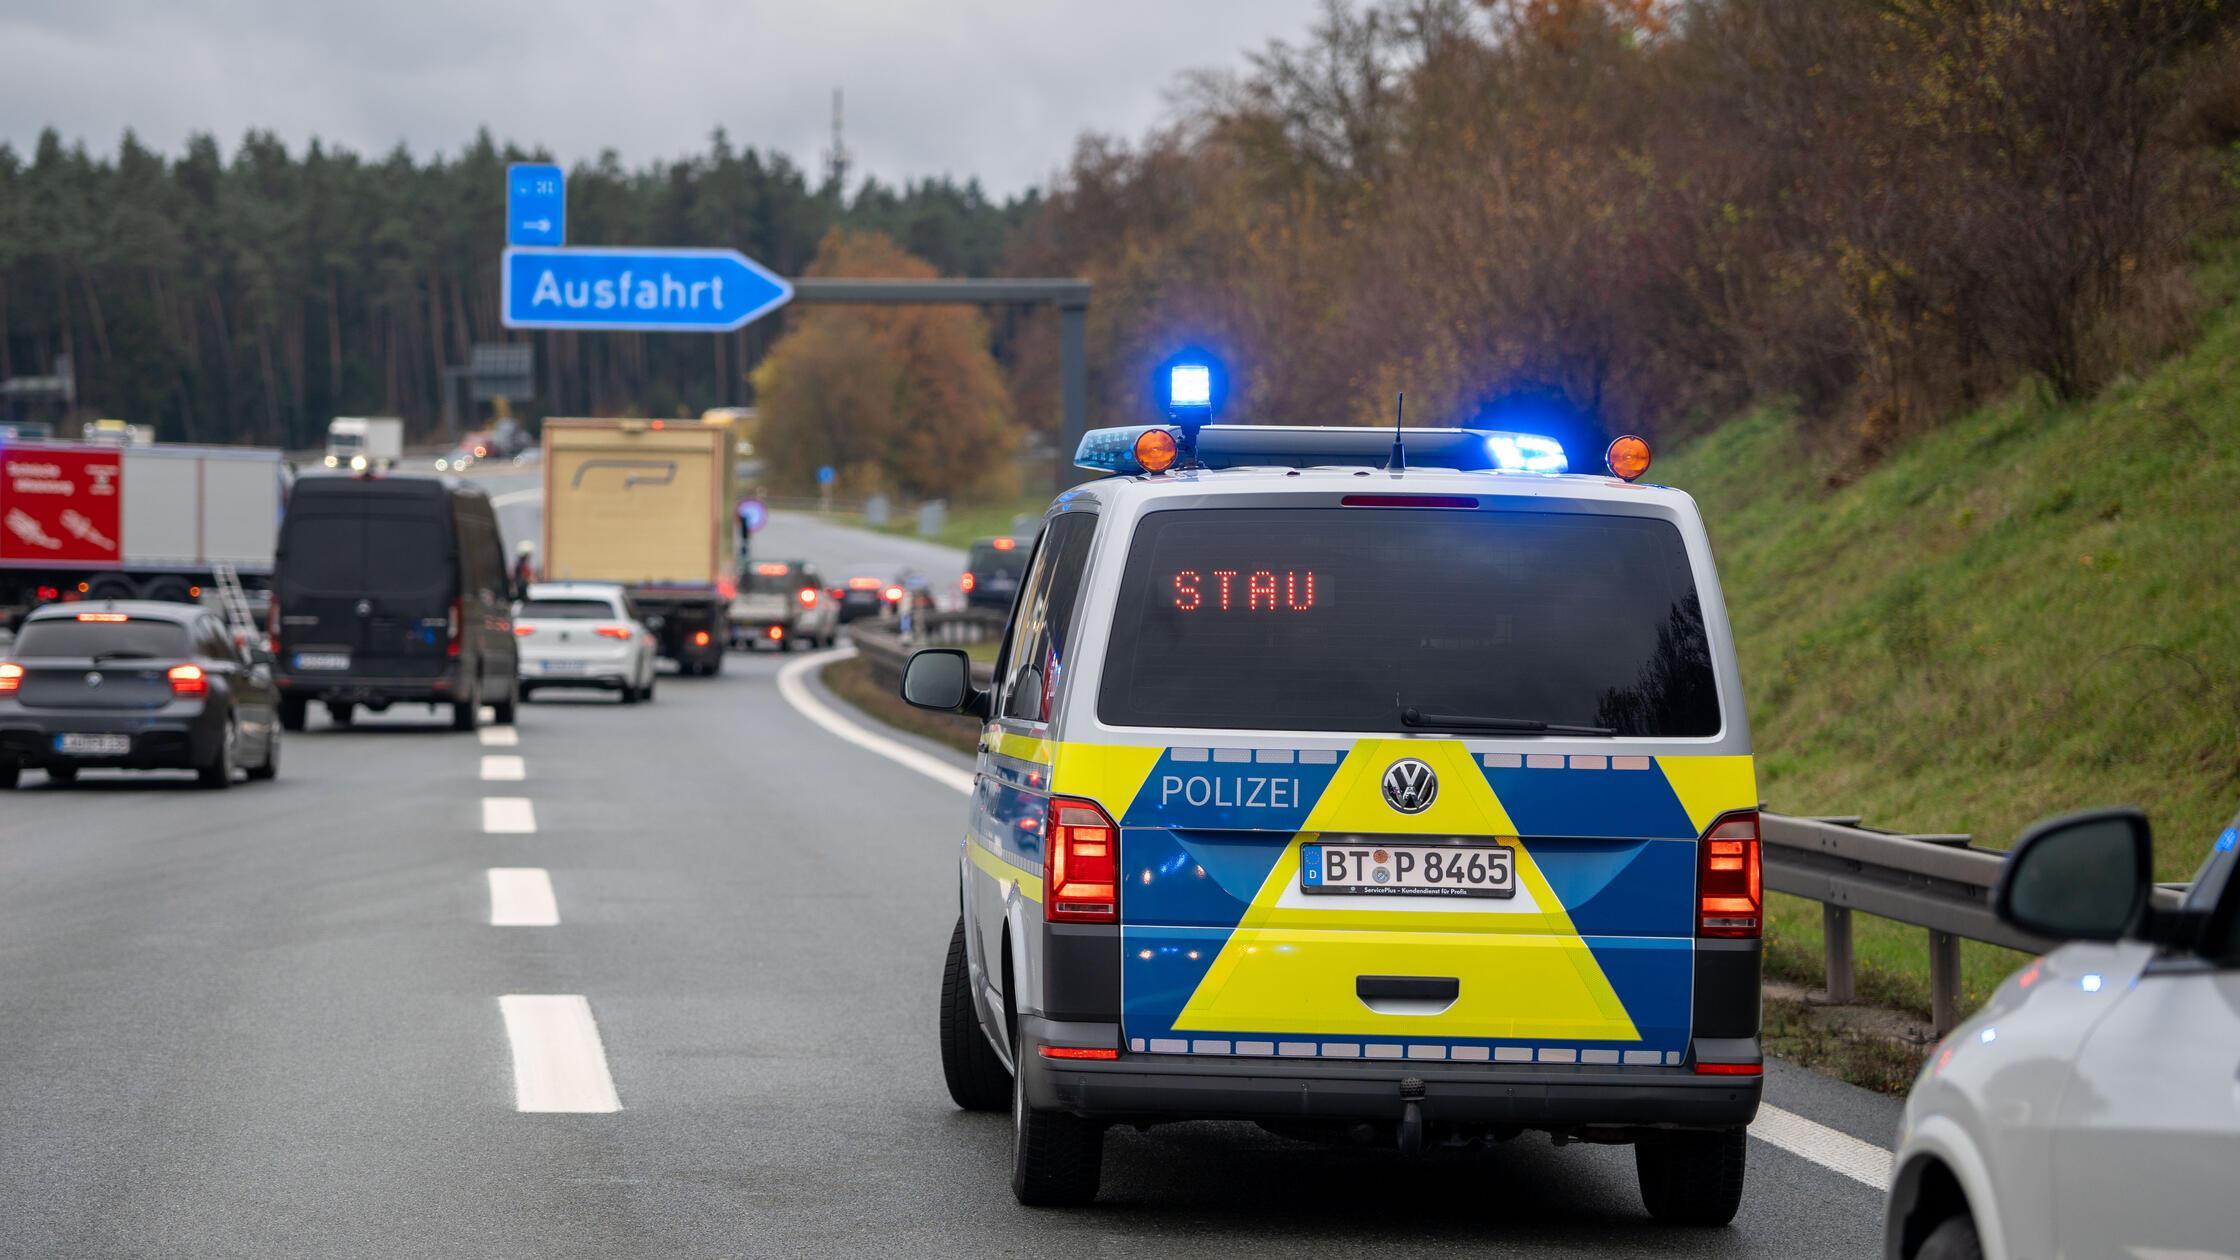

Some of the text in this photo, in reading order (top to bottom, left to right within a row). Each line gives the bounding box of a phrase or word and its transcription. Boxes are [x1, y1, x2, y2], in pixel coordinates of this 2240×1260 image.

[531, 269, 724, 311] Ausfahrt
[1175, 570, 1314, 610] STAU
[1161, 775, 1300, 808] POLIZEI
[1309, 850, 1508, 885] D BT P 8465
[1364, 886, 1396, 894] ServicePlus
[1401, 887, 1440, 895] Kundendienst
